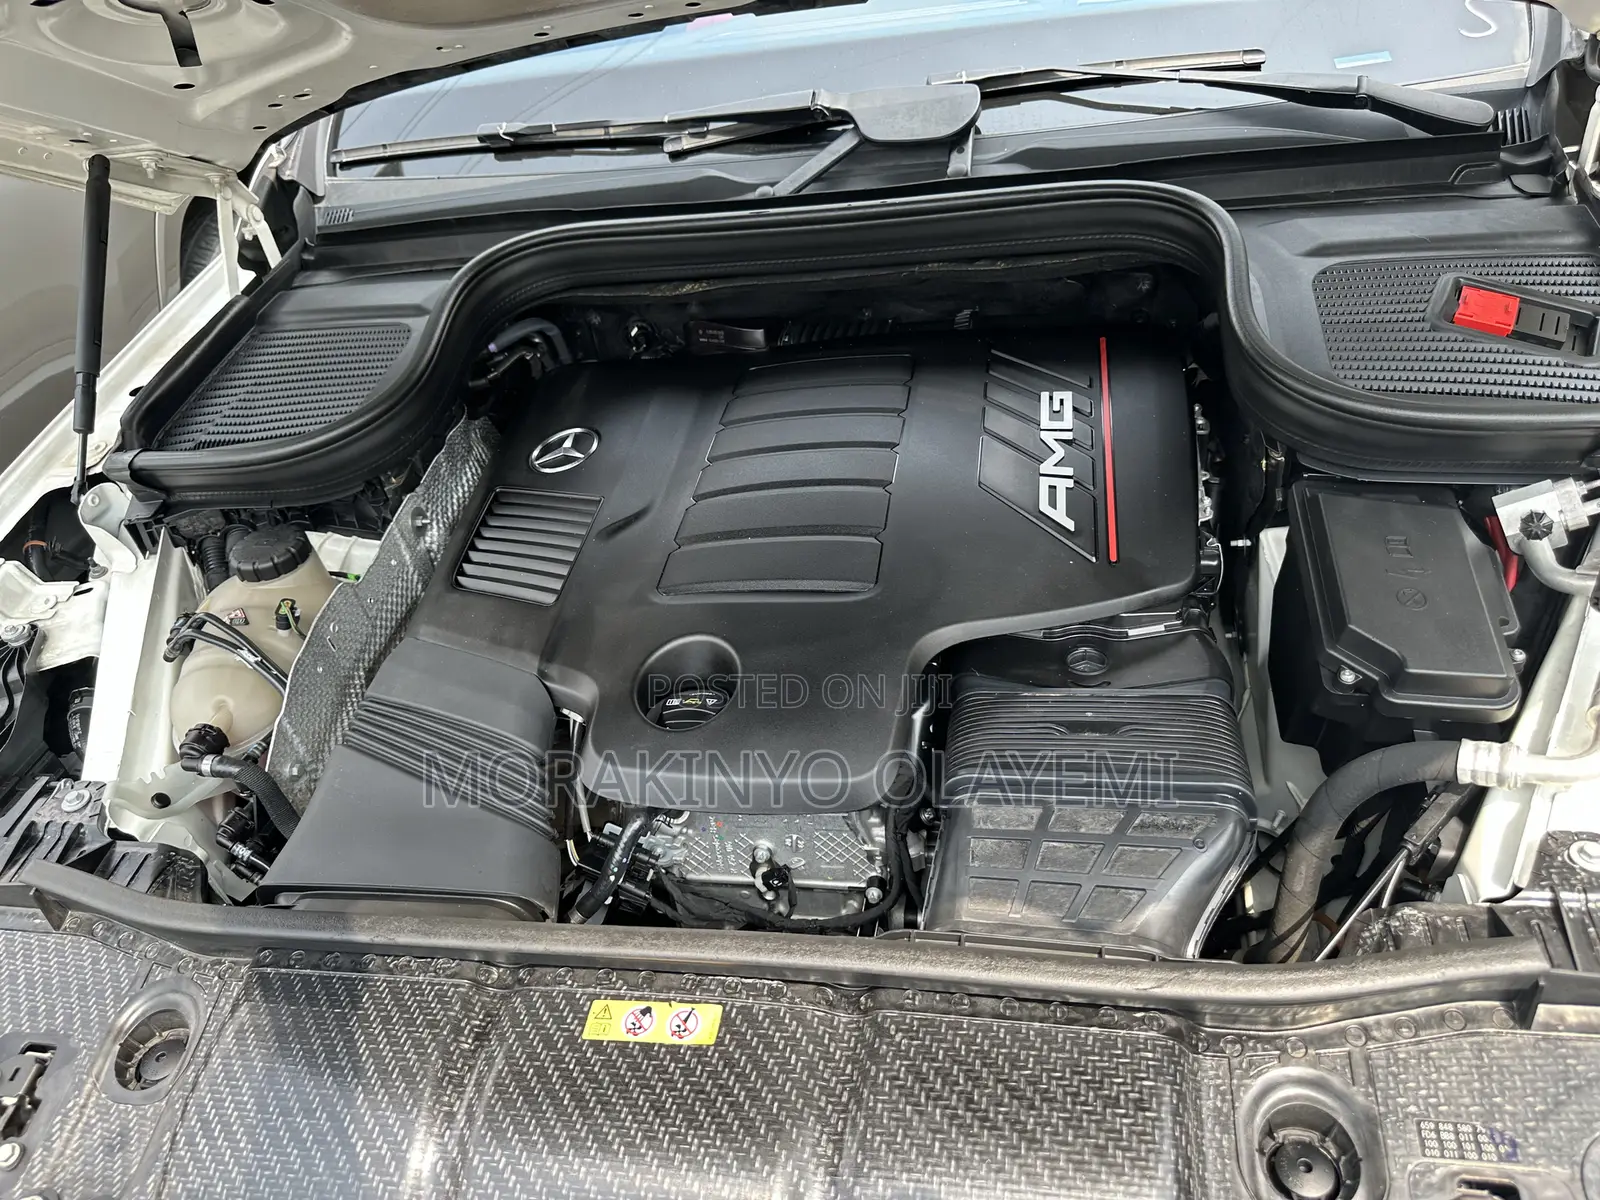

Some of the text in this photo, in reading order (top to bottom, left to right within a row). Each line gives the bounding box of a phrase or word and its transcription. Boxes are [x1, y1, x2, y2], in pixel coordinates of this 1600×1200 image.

[1039, 391, 1075, 532] AMG
[1424, 1140, 1439, 1148] 100
[1461, 1142, 1476, 1150] 101
[1480, 1143, 1496, 1152] 100
[1424, 1148, 1497, 1161] 010 011 100 010
